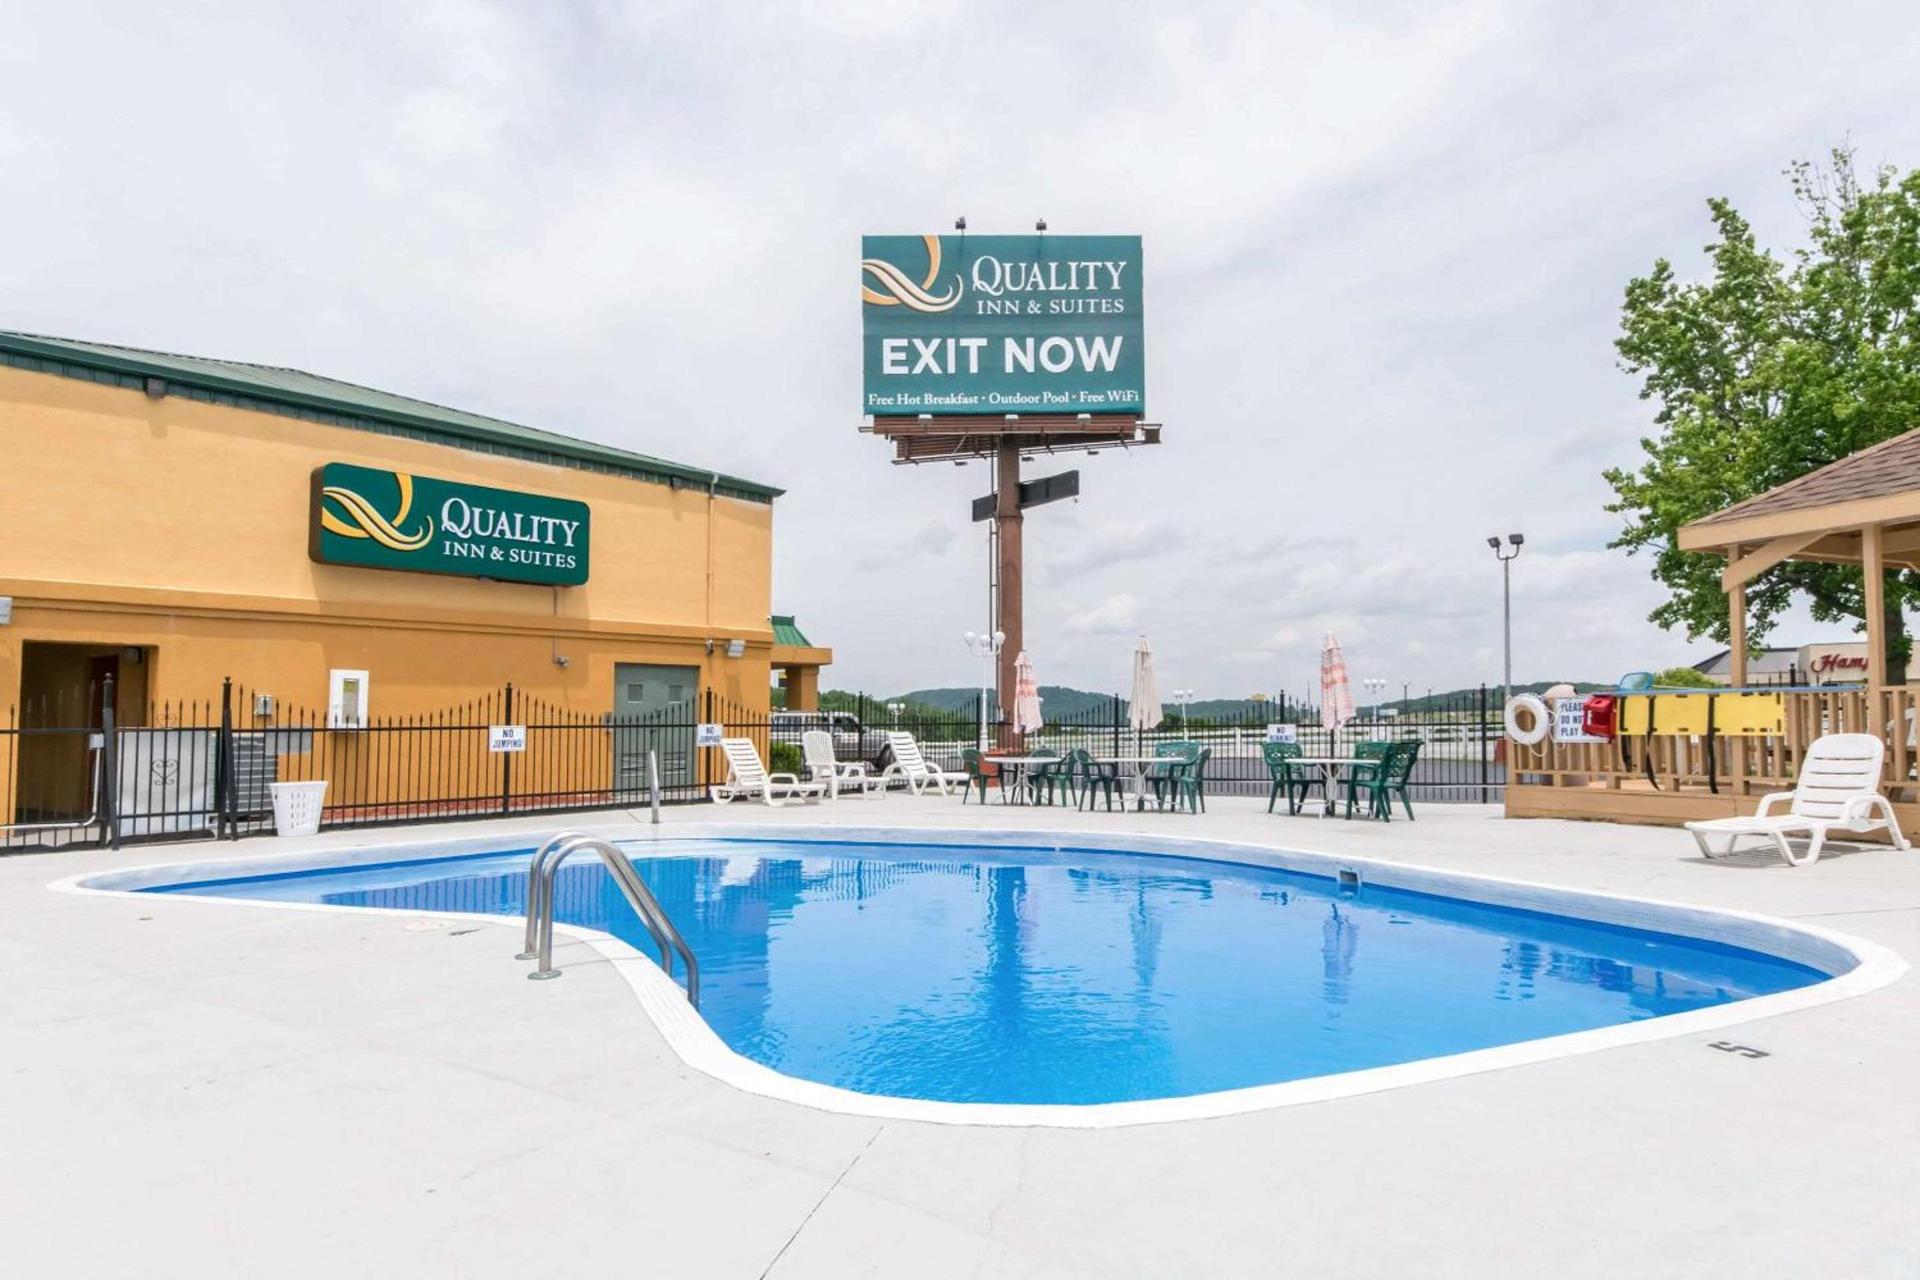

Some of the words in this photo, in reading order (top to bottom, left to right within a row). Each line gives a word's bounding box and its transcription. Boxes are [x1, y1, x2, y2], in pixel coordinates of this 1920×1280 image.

[972, 255, 1127, 296] QUALITY
[976, 300, 1020, 314] INN
[1027, 299, 1042, 314] &
[1049, 298, 1125, 313] SUITES
[882, 338, 988, 374] EXIT
[1004, 336, 1123, 373] NOW
[868, 393, 894, 405] Free
[897, 393, 921, 405] Hot
[924, 392, 979, 405] Breakfast
[988, 392, 1039, 404] Outdoor
[1042, 391, 1070, 403] Pool
[1079, 390, 1105, 403] Free
[1107, 390, 1139, 402] WiFi
[441, 497, 580, 548] QUALITY
[443, 540, 486, 559] INN
[490, 545, 505, 561] &
[509, 548, 577, 569] SUITES
[1560, 702, 1584, 712] PLEAS
[1561, 715, 1570, 724] DO
[1573, 715, 1584, 724] NO
[502, 729, 514, 738] NO
[706, 726, 715, 735] NO
[1276, 726, 1286, 734] NO
[1561, 727, 1579, 736] PLAY
[492, 739, 522, 749] JUMPING
